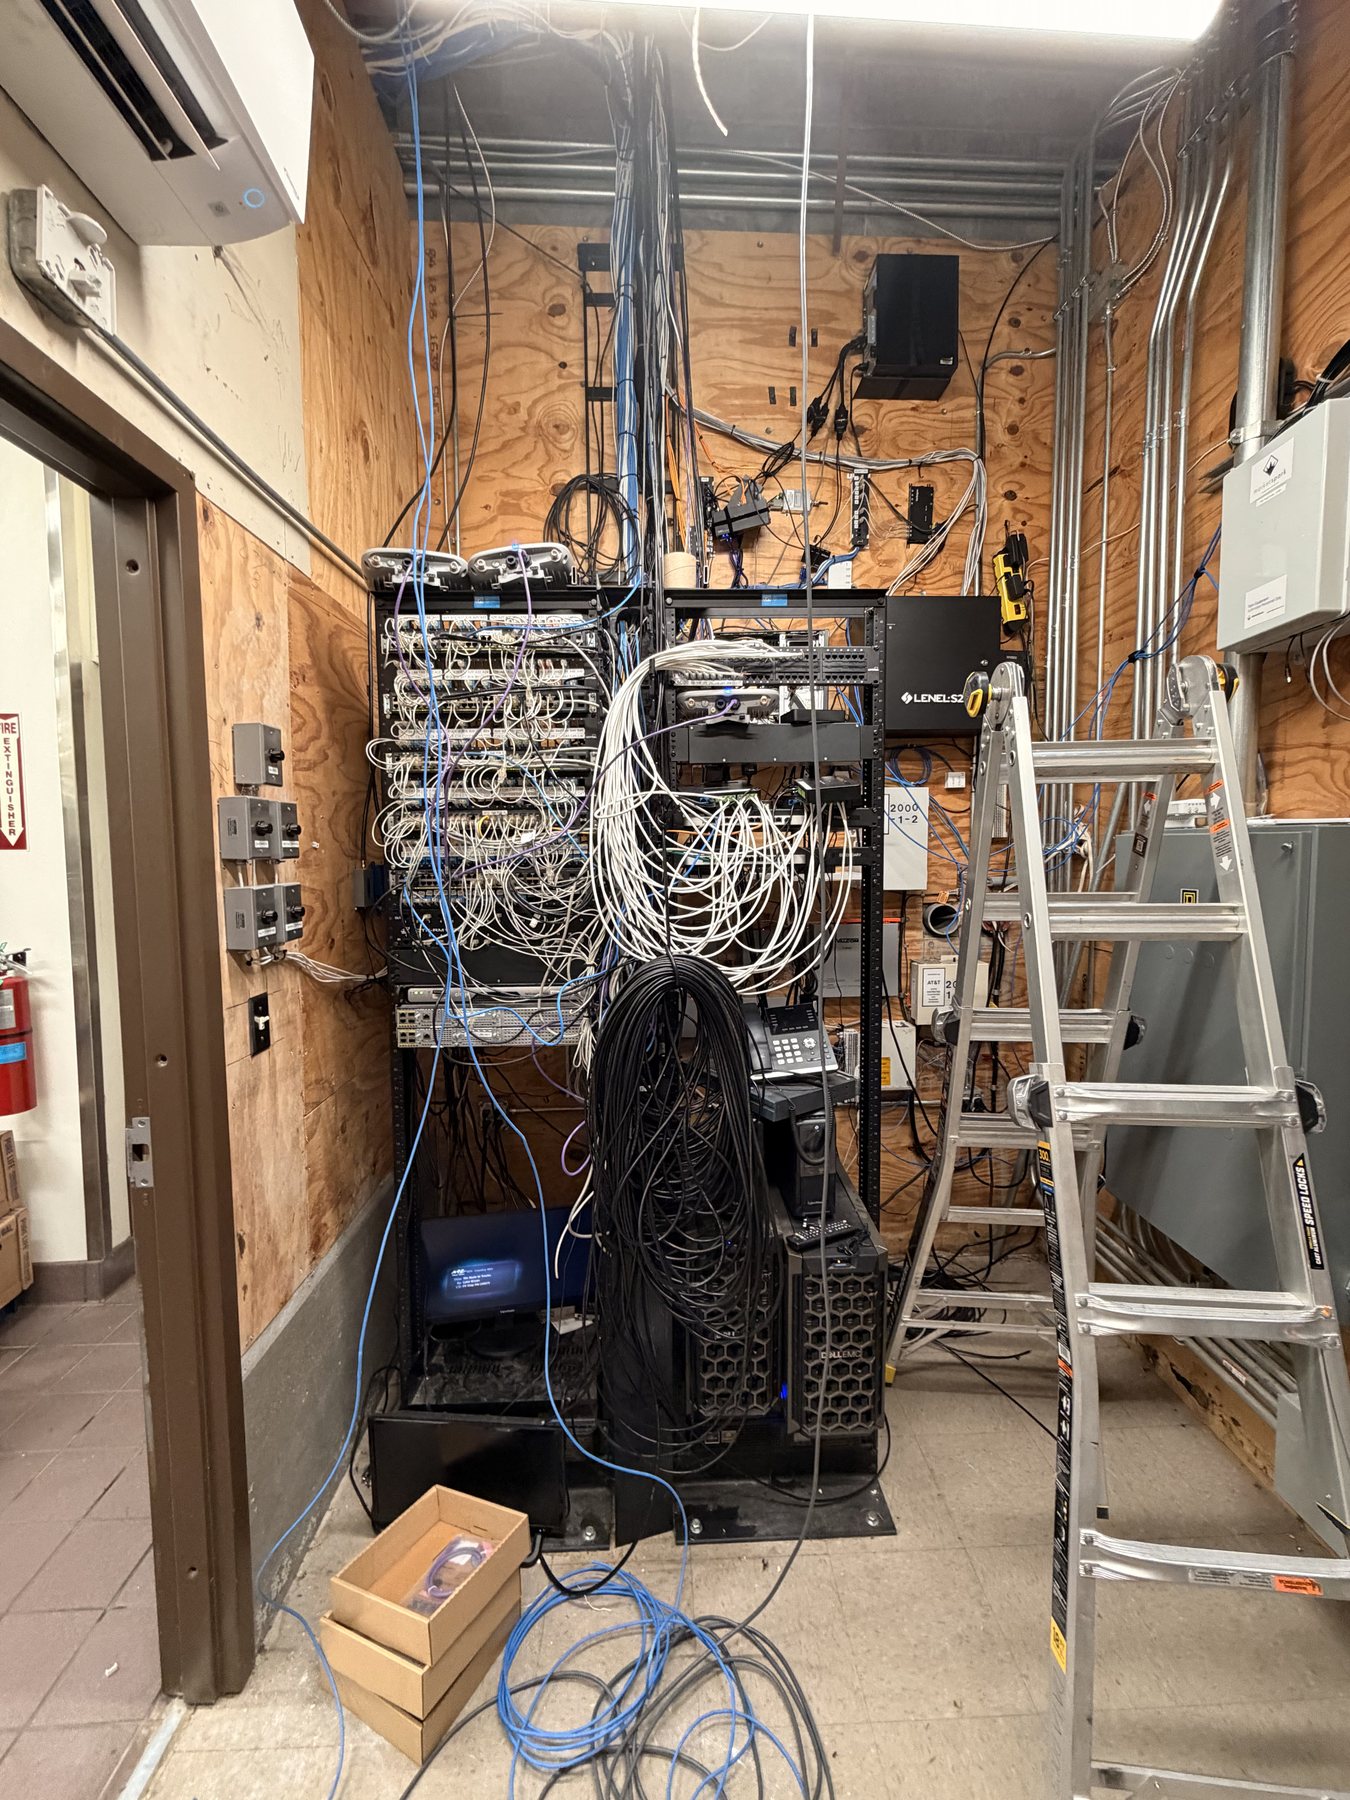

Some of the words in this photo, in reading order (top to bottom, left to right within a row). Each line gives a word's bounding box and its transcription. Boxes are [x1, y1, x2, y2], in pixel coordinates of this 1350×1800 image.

[0, 722, 17, 734] IRE
[3, 737, 16, 836] EXTINGUISHER
[890, 804, 919, 812] 2000
[1295, 1166, 1309, 1196] LOCKS
[1300, 1196, 1315, 1225] SPEED
